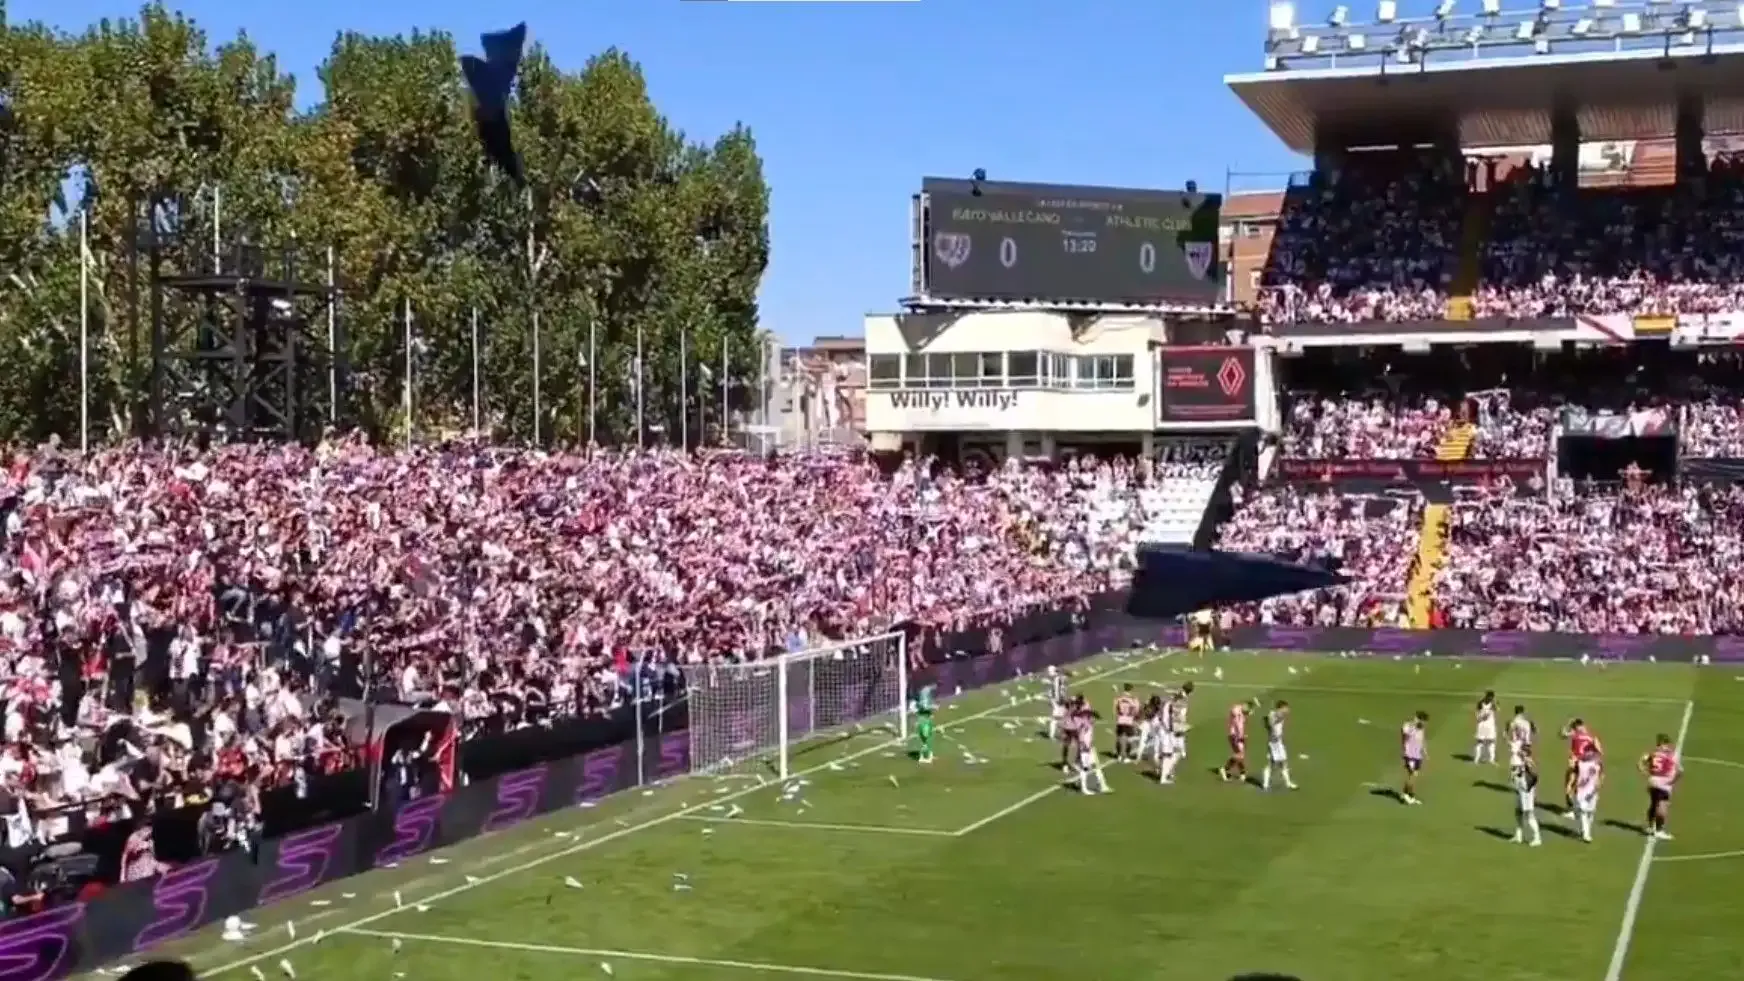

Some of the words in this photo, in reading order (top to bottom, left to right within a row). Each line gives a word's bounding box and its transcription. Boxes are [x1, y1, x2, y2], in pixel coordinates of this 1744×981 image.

[1001, 236, 1017, 268] 0
[1139, 243, 1156, 273] 0
[890, 390, 949, 413] Willy!
[956, 389, 1018, 412] Willy!
